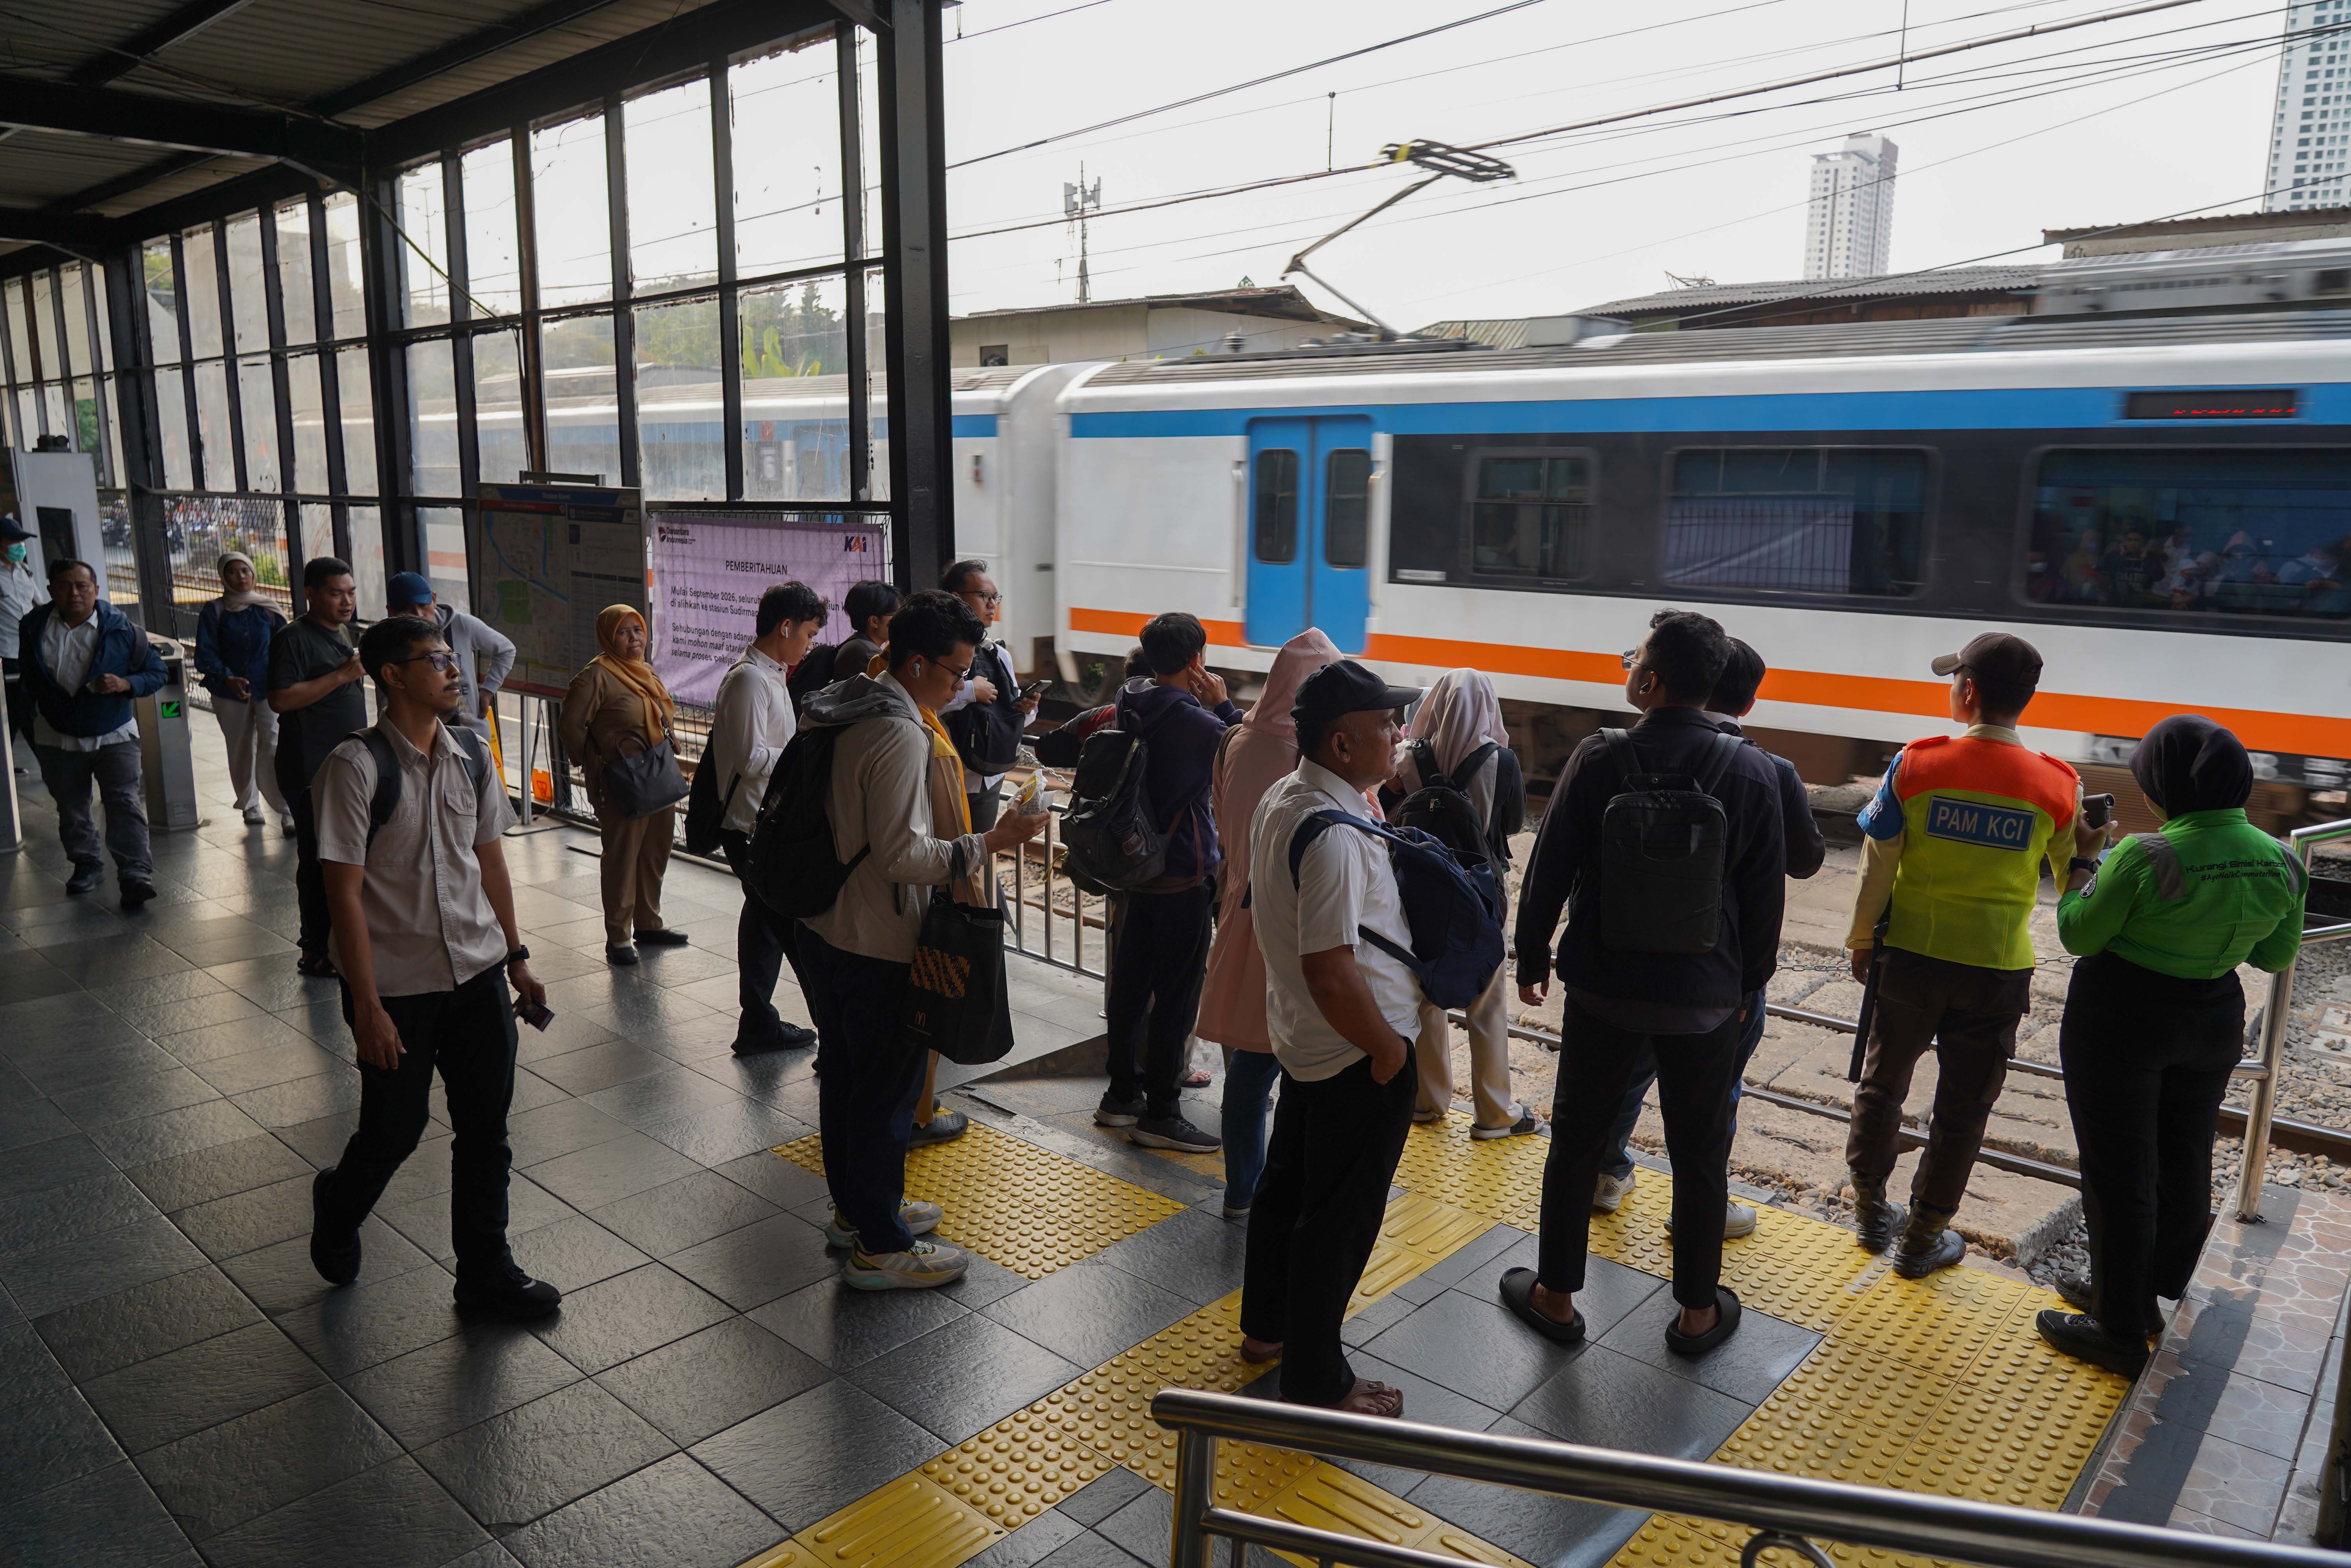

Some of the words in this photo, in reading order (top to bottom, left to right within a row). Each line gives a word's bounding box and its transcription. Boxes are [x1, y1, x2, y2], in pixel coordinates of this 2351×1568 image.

[666, 527, 689, 535] Danantara
[667, 535, 688, 544] Indonesia
[844, 536, 867, 552] KAI
[725, 561, 787, 575] PEMBERITAHUAN
[671, 586, 688, 596] Mulai
[690, 588, 719, 600] September
[721, 592, 737, 603] 2026,
[671, 598, 676, 607] di
[678, 599, 700, 610] alihkan
[701, 601, 708, 611] ke
[709, 604, 728, 613] stasiun
[672, 622, 709, 637] Sehubungan
[711, 627, 732, 640] dengan
[734, 631, 753, 643] adanya
[672, 635, 686, 645] kami
[688, 638, 708, 648] mohon
[709, 642, 724, 650] maaf
[671, 647, 690, 658] selama
[692, 652, 712, 661] proses
[1936, 806, 1979, 834] PAM
[1987, 815, 2024, 841] KCI
[2186, 862, 2227, 873] Kurangi
[2257, 860, 2286, 868] Karbon
